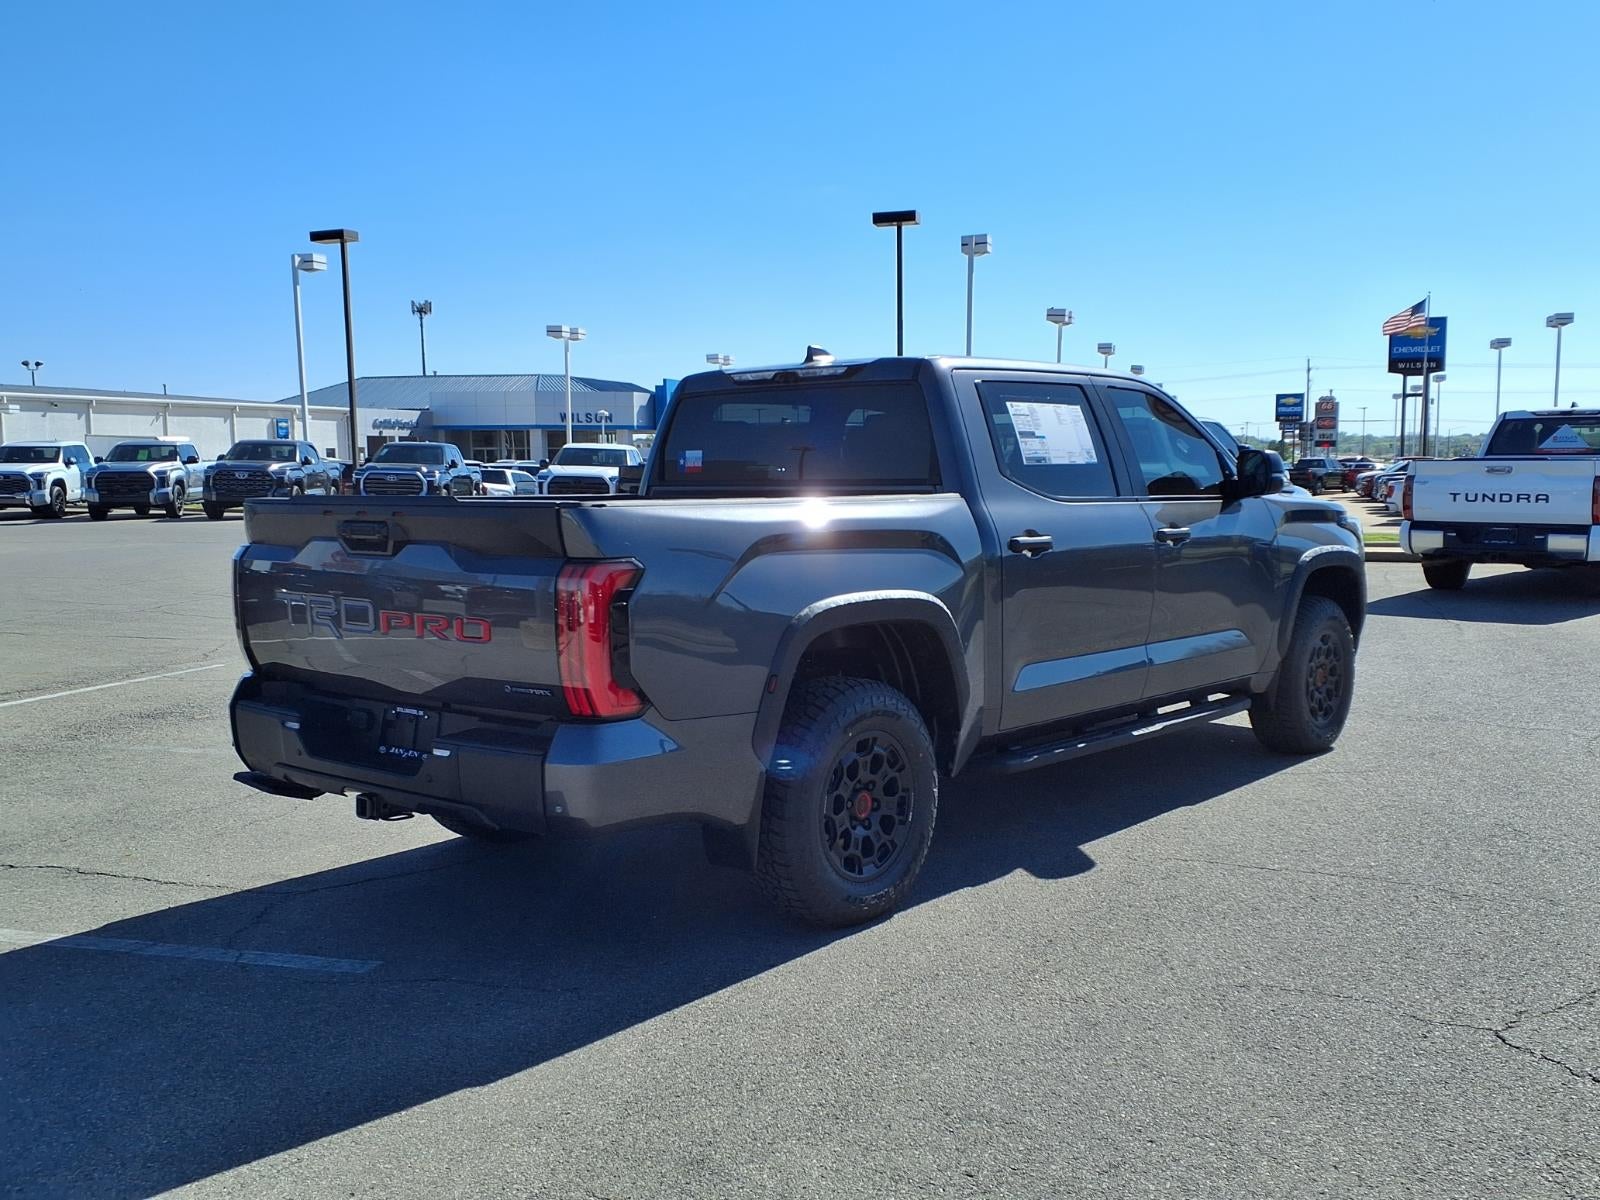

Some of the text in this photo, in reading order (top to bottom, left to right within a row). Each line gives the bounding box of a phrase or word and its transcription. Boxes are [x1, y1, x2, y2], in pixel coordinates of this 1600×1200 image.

[1393, 345, 1441, 354] CHEVROLET
[1398, 361, 1437, 369] WILSON
[560, 411, 613, 424] WILSON
[1449, 492, 1550, 504] TUNDRA
[274, 589, 492, 644] TRD PRO
